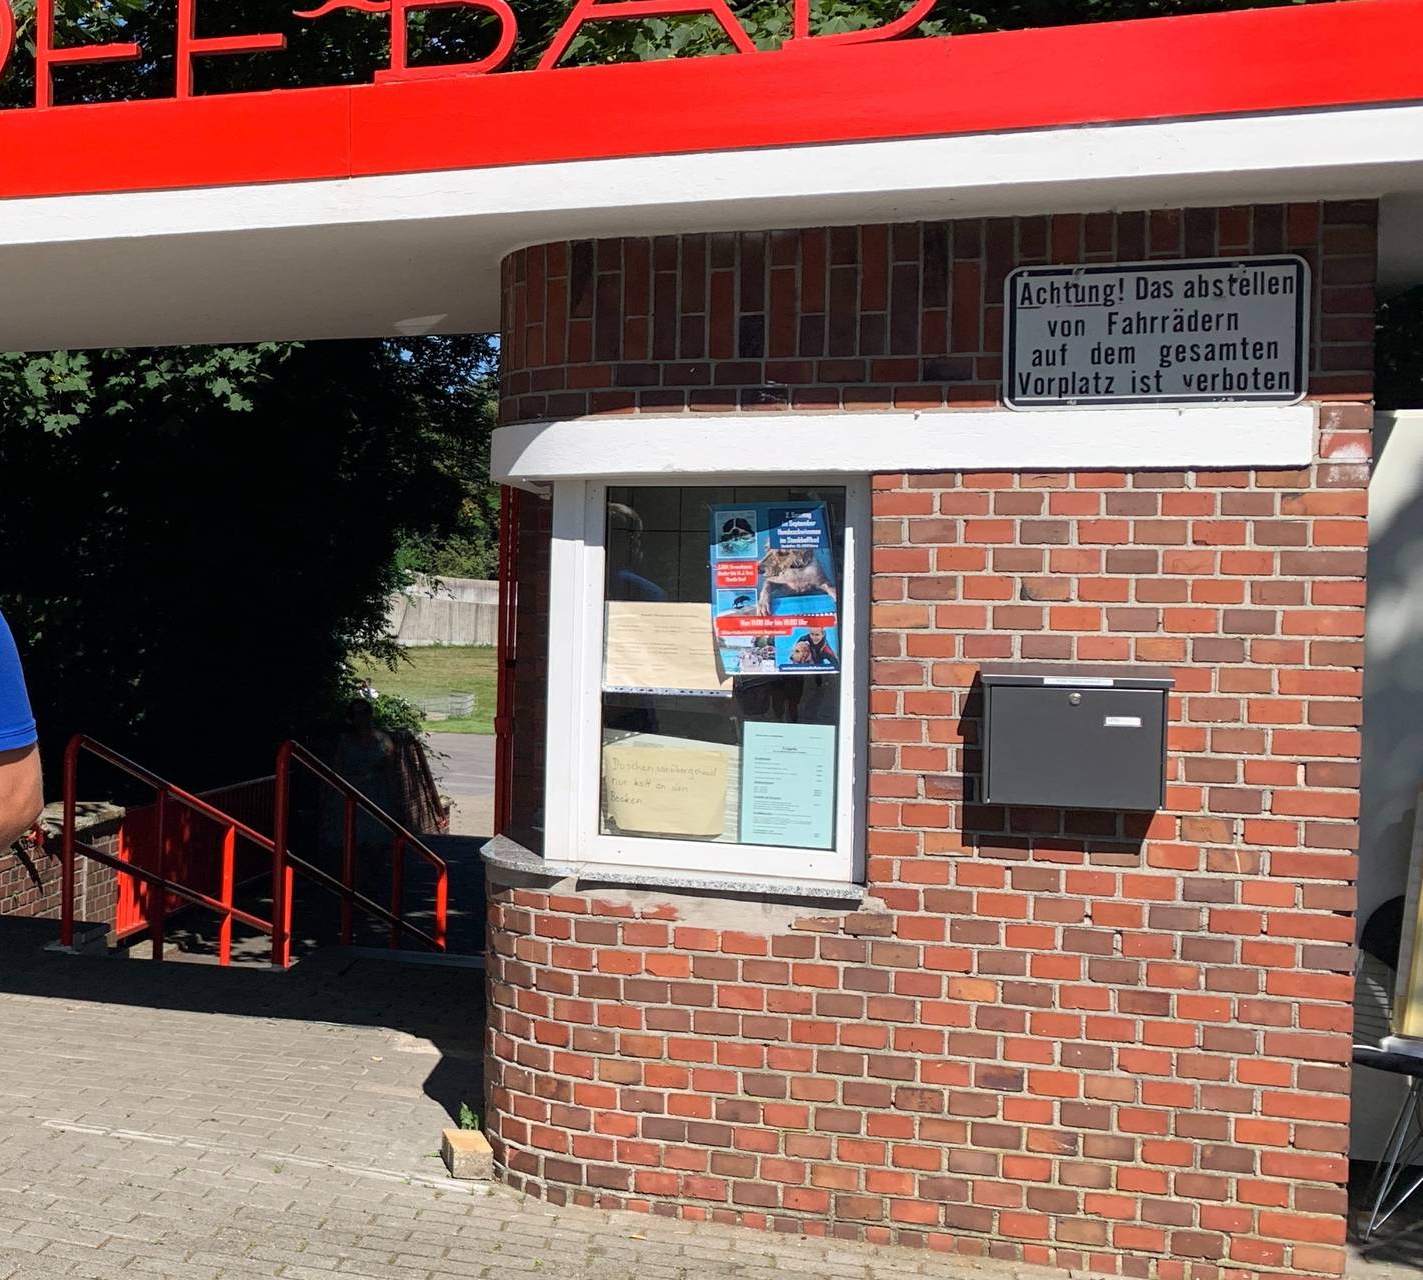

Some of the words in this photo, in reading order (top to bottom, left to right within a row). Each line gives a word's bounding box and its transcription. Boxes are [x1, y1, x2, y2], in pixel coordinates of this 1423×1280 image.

[1019, 278, 1125, 306] Achtung!
[1136, 276, 1174, 300] Das
[1183, 272, 1295, 300] abstellen
[1047, 317, 1086, 338] von
[1107, 308, 1240, 336] Fahrrädern
[1031, 343, 1069, 367] auf
[1090, 342, 1136, 366] dem
[1159, 337, 1279, 368] gesamten
[1018, 370, 1115, 399] Vorplatz
[1131, 369, 1164, 394] ist
[1182, 367, 1291, 393] verboten
[612, 757, 654, 771] Duschen
[611, 777, 627, 786] nur
